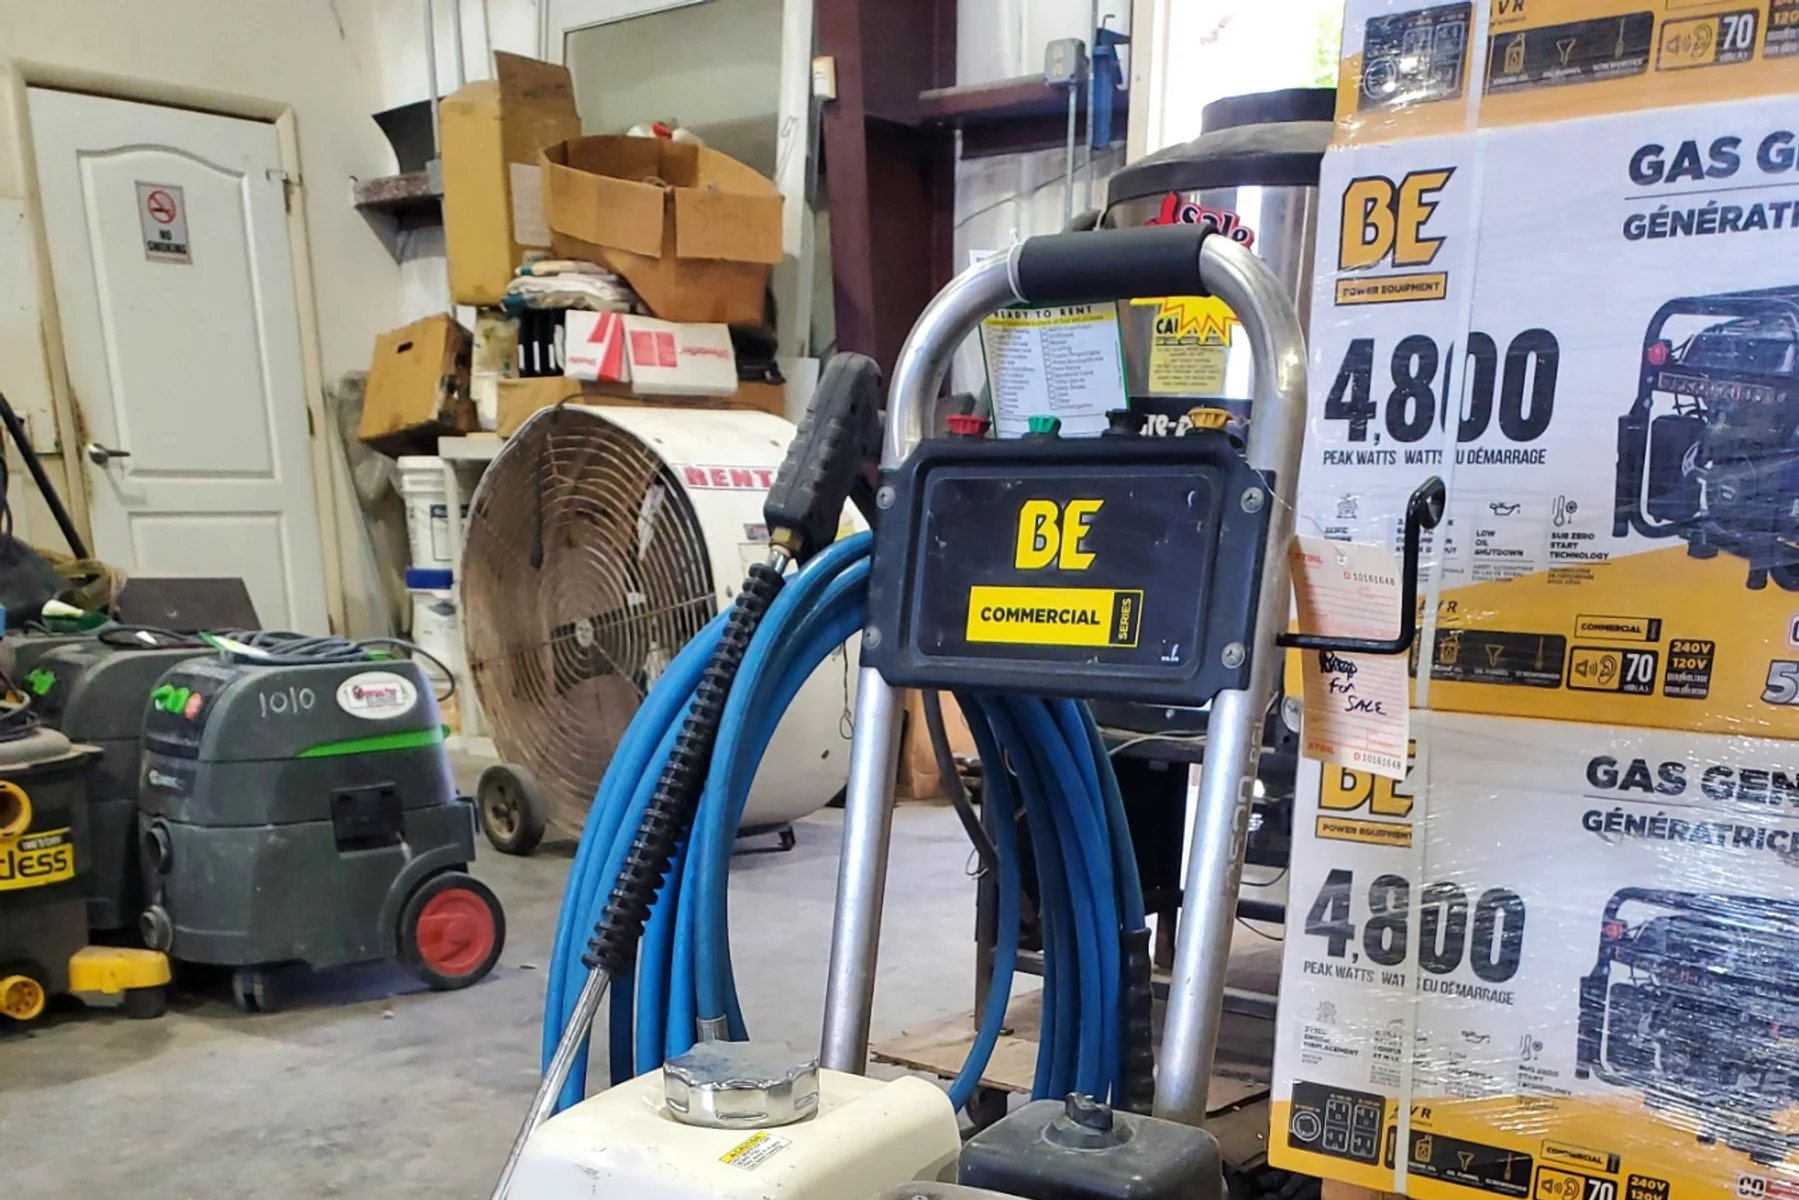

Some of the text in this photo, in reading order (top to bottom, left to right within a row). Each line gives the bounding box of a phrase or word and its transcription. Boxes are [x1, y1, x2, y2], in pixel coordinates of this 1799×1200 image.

[1723, 14, 1754, 49] 70
[1628, 130, 1799, 187] GAS G
[1338, 166, 1458, 271] BE
[1342, 281, 1441, 297] POWER EQUIPMENT
[1036, 309, 1051, 318] TO
[1060, 306, 1092, 317] RENT
[1323, 450, 1354, 465] PEAK
[1356, 450, 1396, 465] WATTS
[1467, 447, 1547, 465] DÉMARRAGE
[1015, 499, 1104, 570] BE
[1476, 529, 1496, 538] LOW
[1551, 532, 1596, 541] SUB ZERO
[1475, 539, 1489, 547] OIL
[1550, 542, 1579, 550] START
[1474, 549, 1524, 557] SHUTDOWN
[1549, 551, 1610, 560] TECHNOLOGY
[980, 606, 1101, 625] COMMERCIAL
[1118, 597, 1133, 640] SERIES
[1580, 621, 1642, 635] COMMERCIAL
[1672, 641, 1712, 655] 240V
[1625, 652, 1654, 684] 70
[1672, 657, 1708, 670] 120V
[1586, 755, 1687, 796] GAS
[1323, 823, 1357, 835] POWER
[1304, 868, 1526, 984] 4,800
[1303, 960, 1333, 977] PEAK
[1335, 962, 1374, 982] WATTS
[1423, 978, 1437, 991] EU
[1440, 978, 1515, 1006] DÉMARRAGE
[1630, 1176, 1667, 1192] 240V
